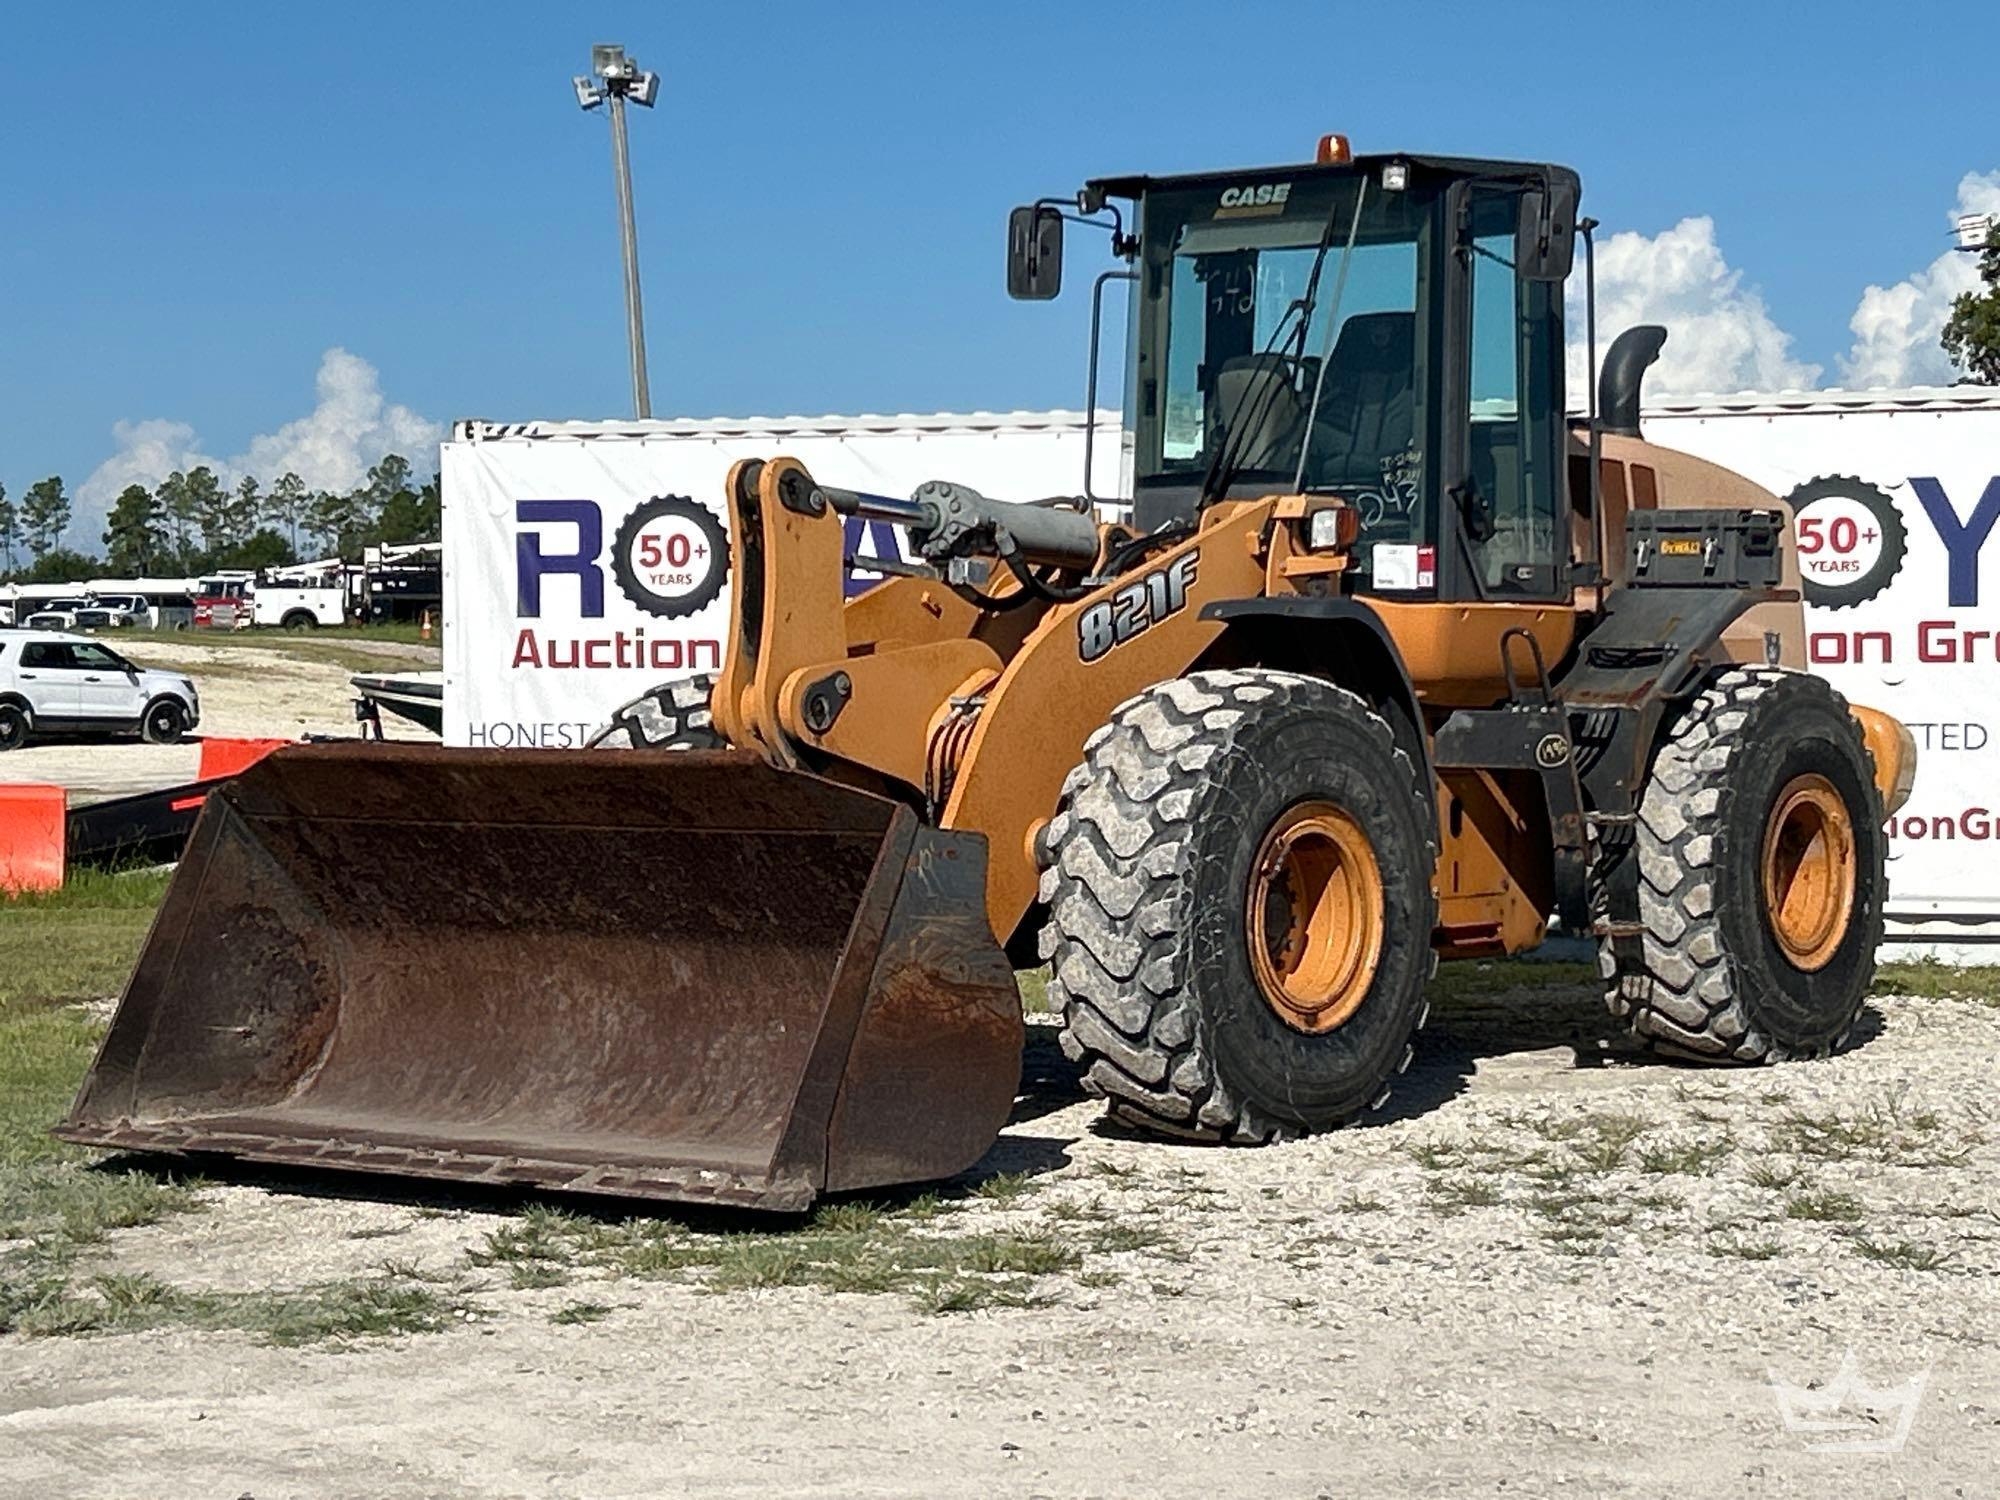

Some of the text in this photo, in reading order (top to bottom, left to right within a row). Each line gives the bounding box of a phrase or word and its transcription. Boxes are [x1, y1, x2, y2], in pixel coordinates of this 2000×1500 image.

[1220, 182, 1291, 208] CASE
[639, 533, 708, 569] 50+
[1798, 517, 1879, 554] 50+
[649, 573, 693, 586] YEARS
[1808, 560, 1860, 573] YEARS
[1078, 546, 1200, 664] 821F
[511, 627, 721, 669] Auction
[1917, 621, 2000, 664] Gr
[468, 722, 592, 748] HONEST
[1904, 723, 1988, 750] TED
